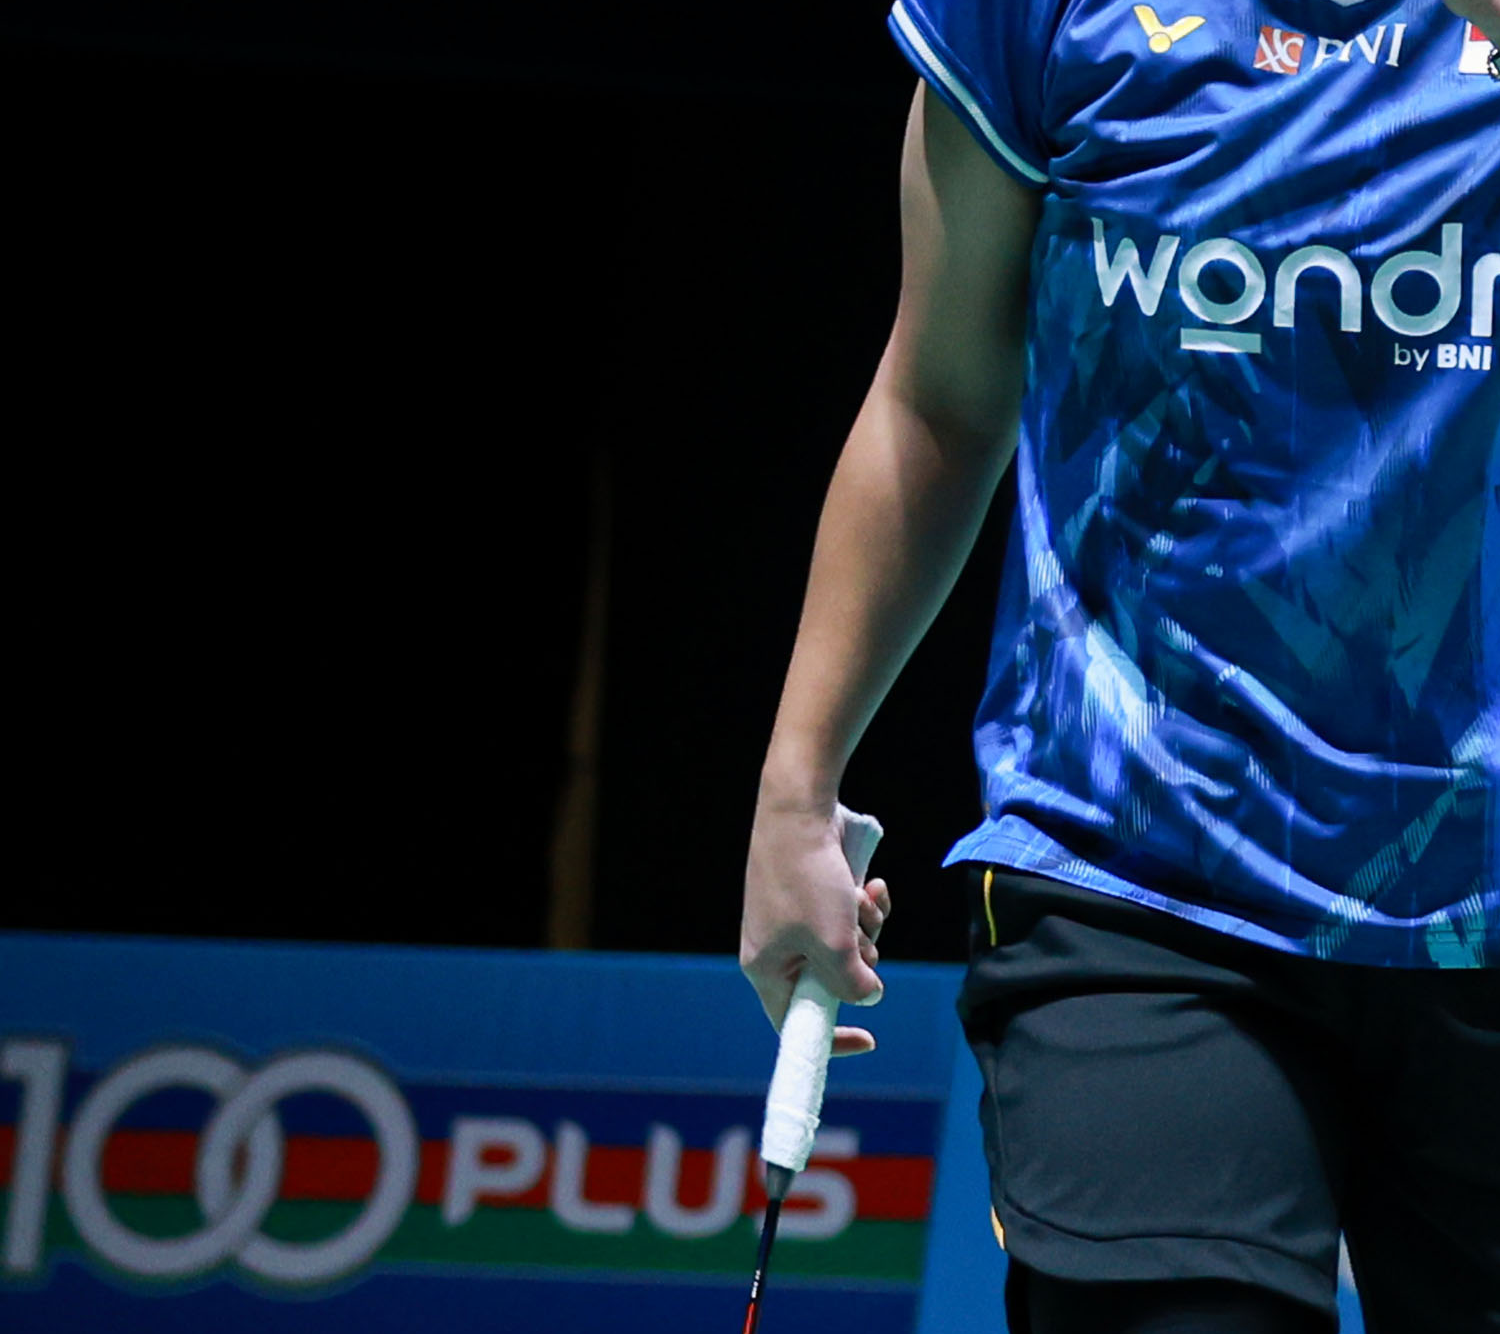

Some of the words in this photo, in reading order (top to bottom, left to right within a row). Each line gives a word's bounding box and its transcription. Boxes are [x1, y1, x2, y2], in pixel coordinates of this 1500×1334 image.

[1394, 342, 1430, 372] by
[1437, 343, 1493, 371] BNI
[0, 1039, 416, 1279] 100
[442, 1115, 860, 1242] PLUS
